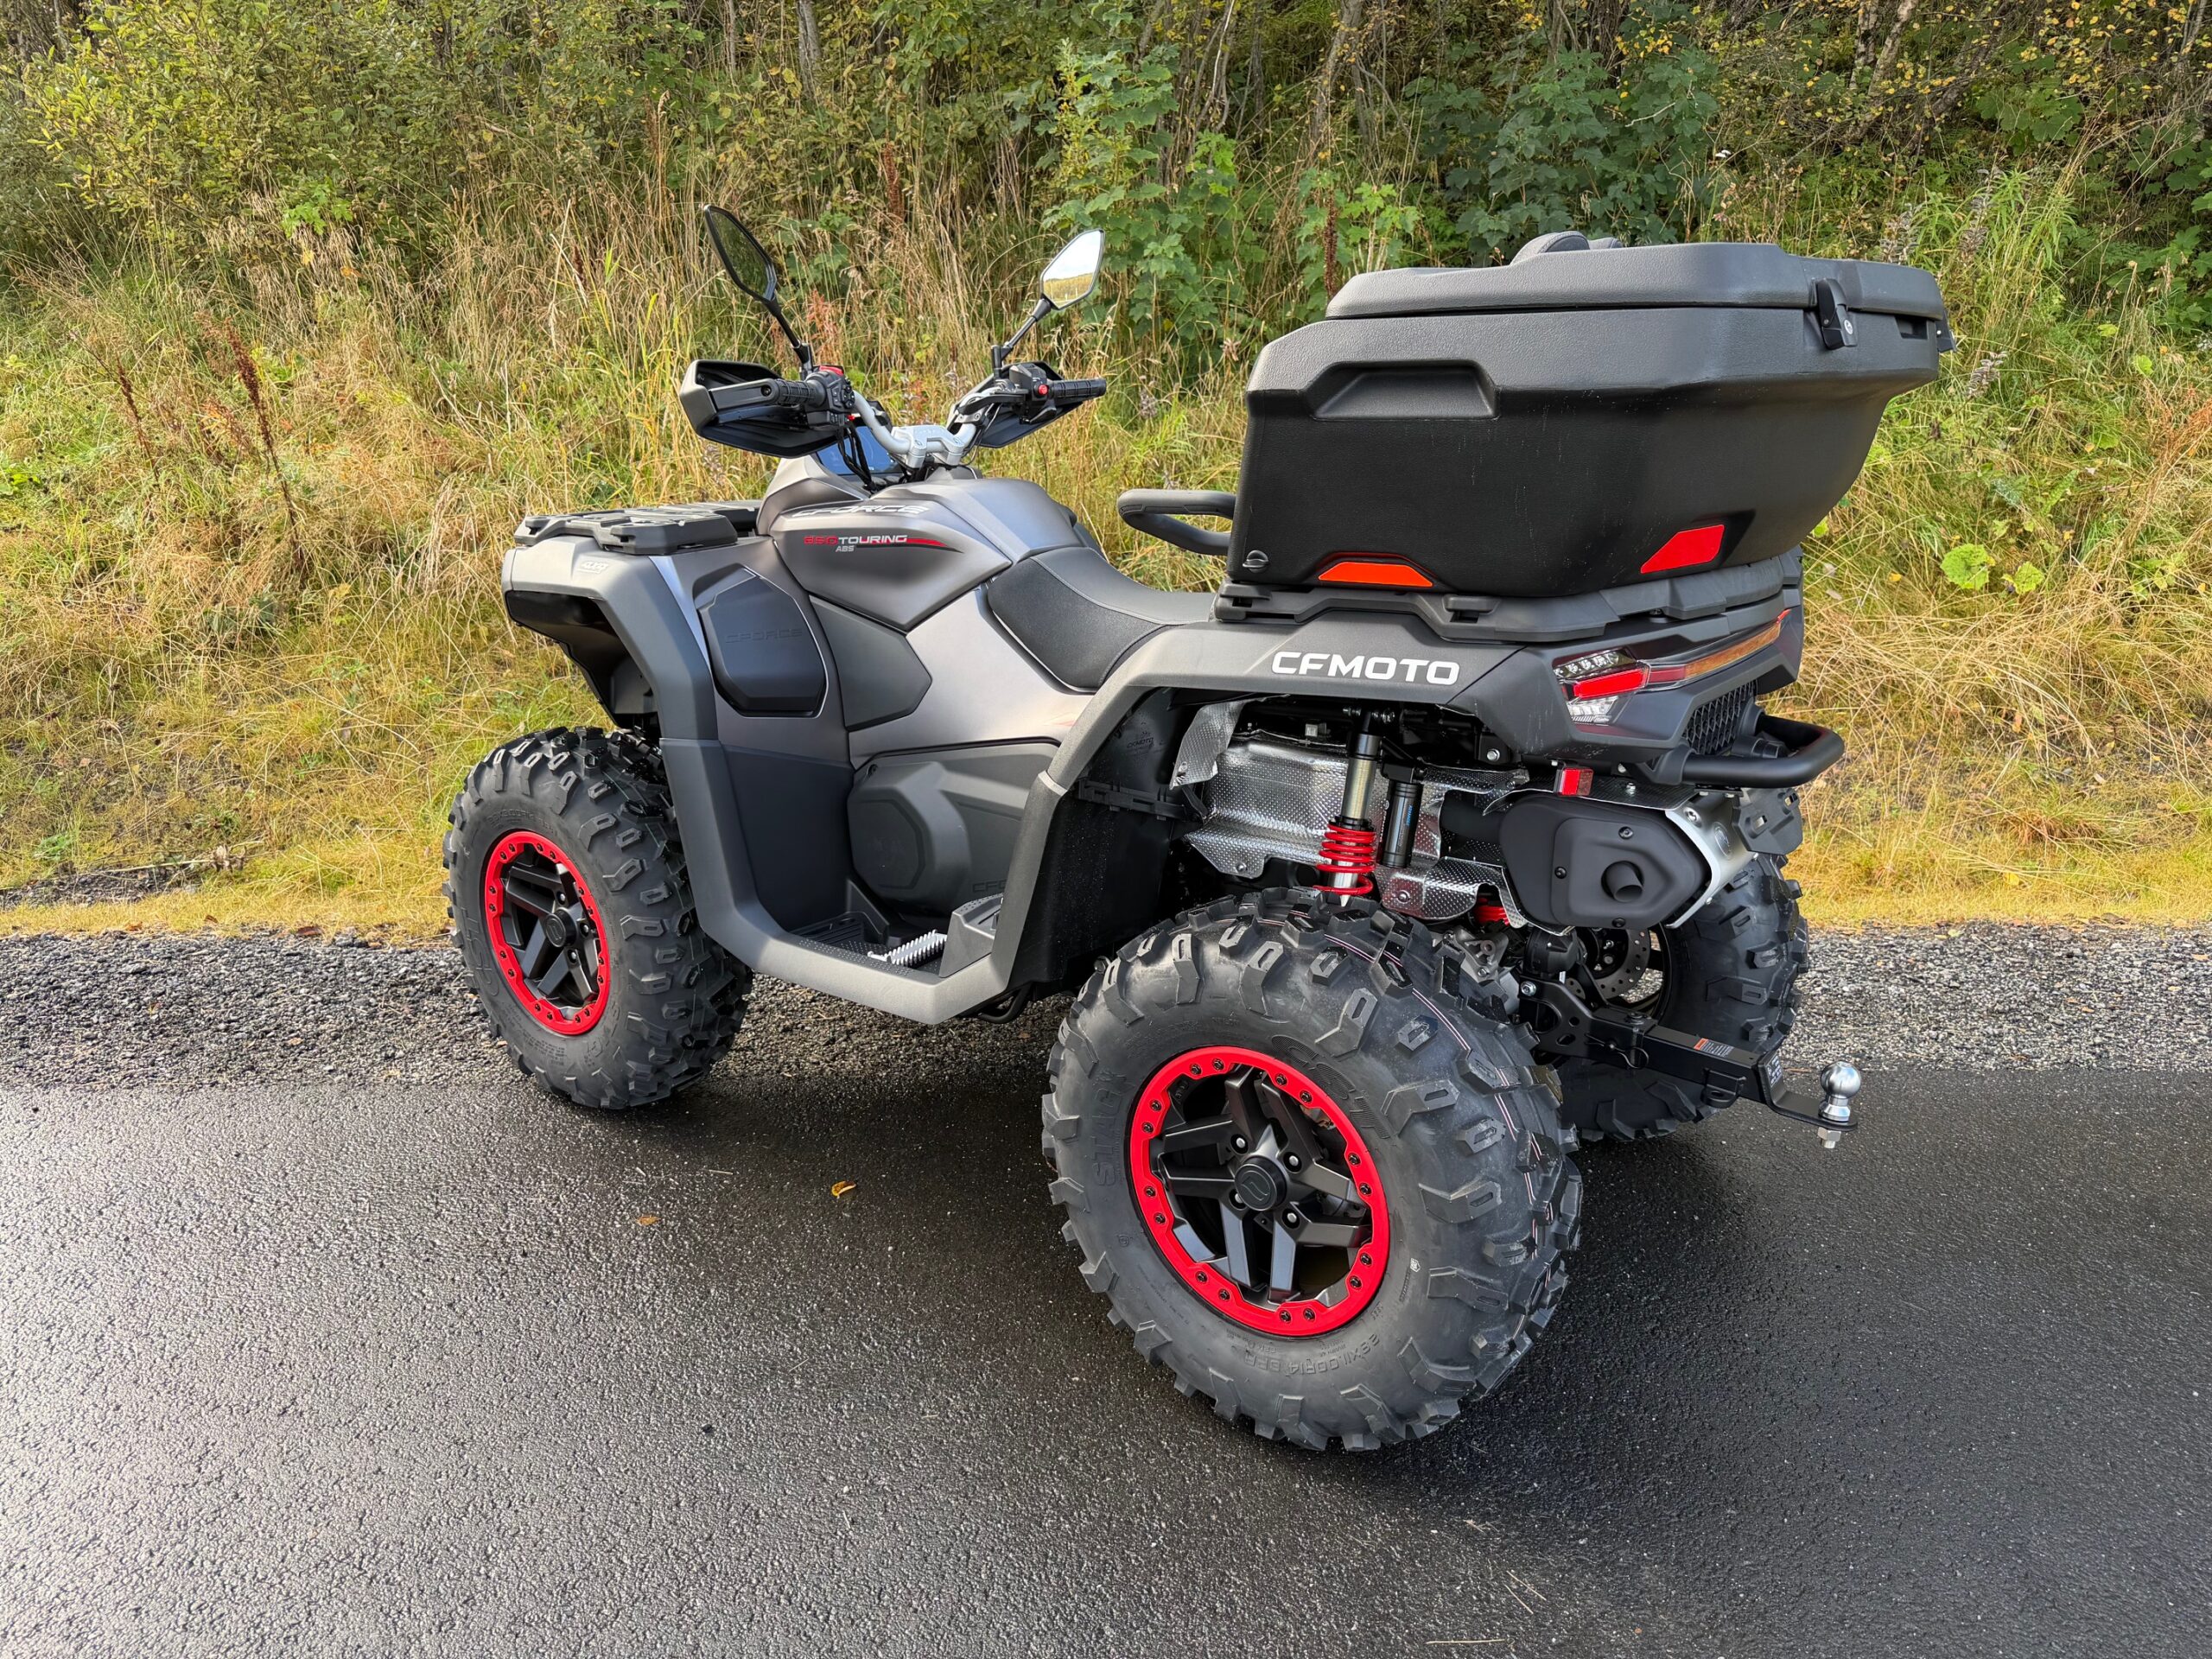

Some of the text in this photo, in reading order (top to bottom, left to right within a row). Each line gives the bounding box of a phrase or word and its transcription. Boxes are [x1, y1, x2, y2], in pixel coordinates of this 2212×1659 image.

[838, 535, 907, 544] TOURING
[1271, 651, 1460, 685] CFMOTO
[1271, 1034, 1390, 1139] CST
